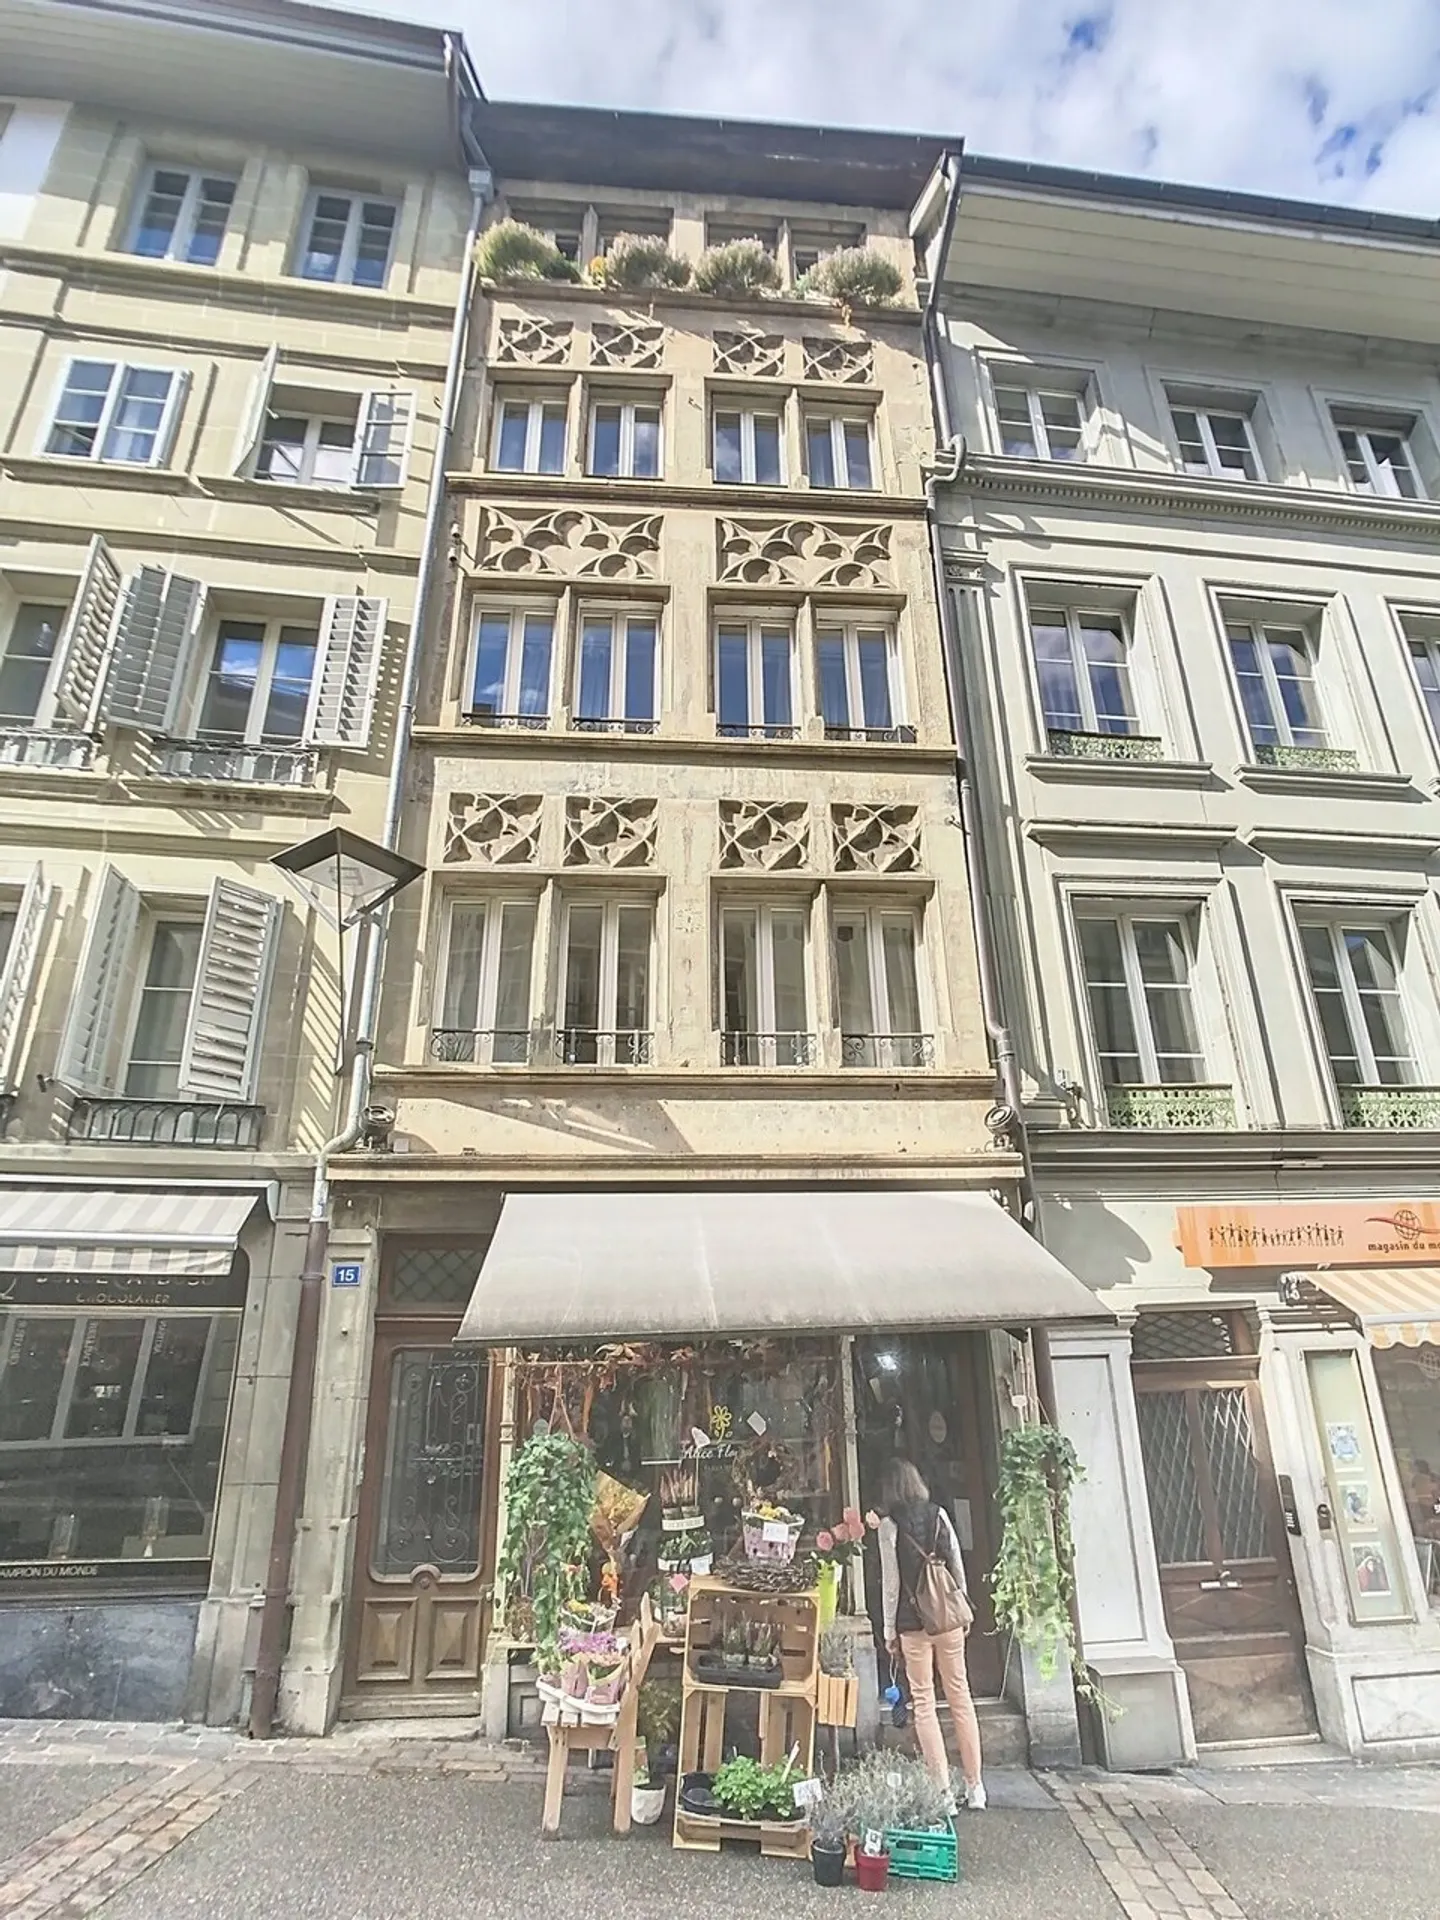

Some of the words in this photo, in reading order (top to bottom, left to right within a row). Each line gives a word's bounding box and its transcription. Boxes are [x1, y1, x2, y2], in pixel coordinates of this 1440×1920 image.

[1368, 1240, 1409, 1253] magasin
[1413, 1240, 1425, 1250] du
[338, 1269, 355, 1282] 15
[43, 1567, 58, 1577] DU
[59, 1565, 98, 1576] MONDE
